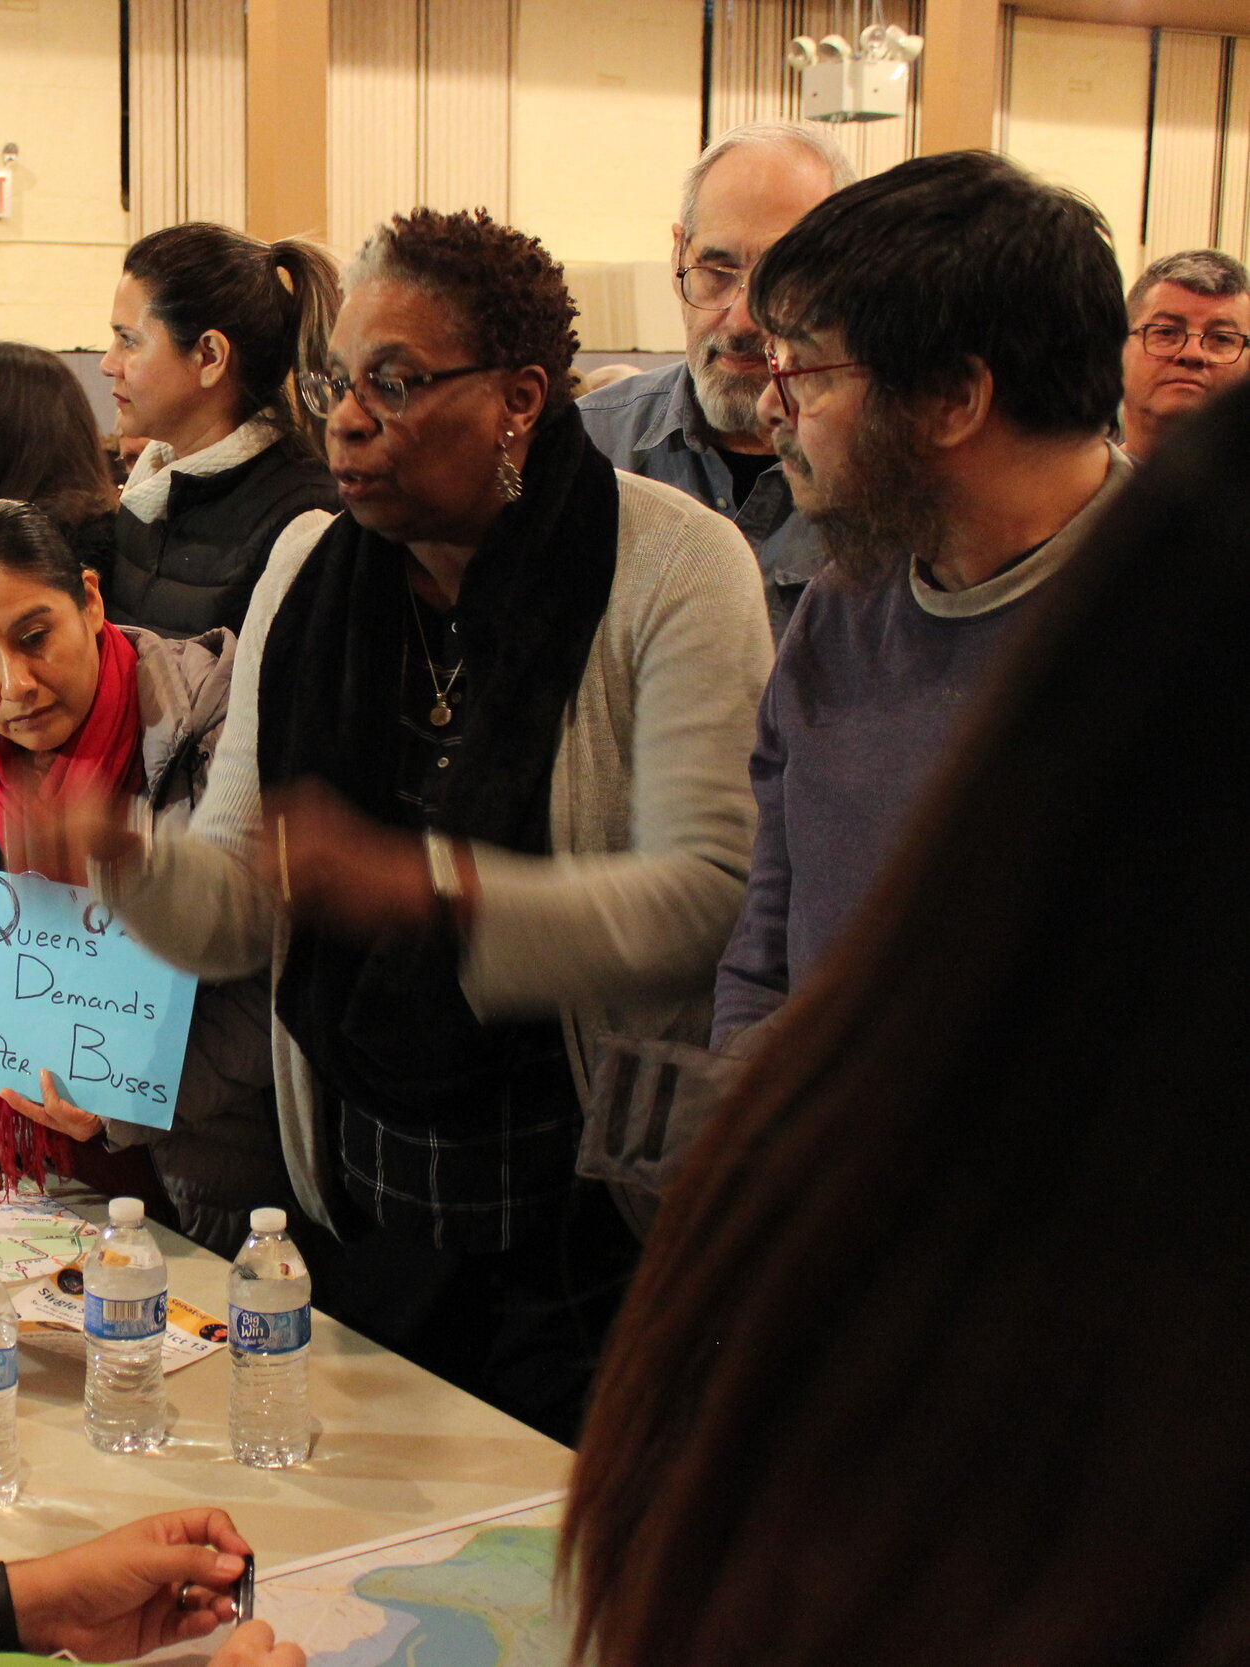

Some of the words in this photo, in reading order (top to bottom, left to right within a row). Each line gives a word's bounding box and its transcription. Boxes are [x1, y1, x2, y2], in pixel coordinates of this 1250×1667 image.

[15, 952, 156, 1020] Demands
[69, 1023, 168, 1104] Buses
[240, 1324, 265, 1338] Win
[241, 1312, 260, 1328] Big
